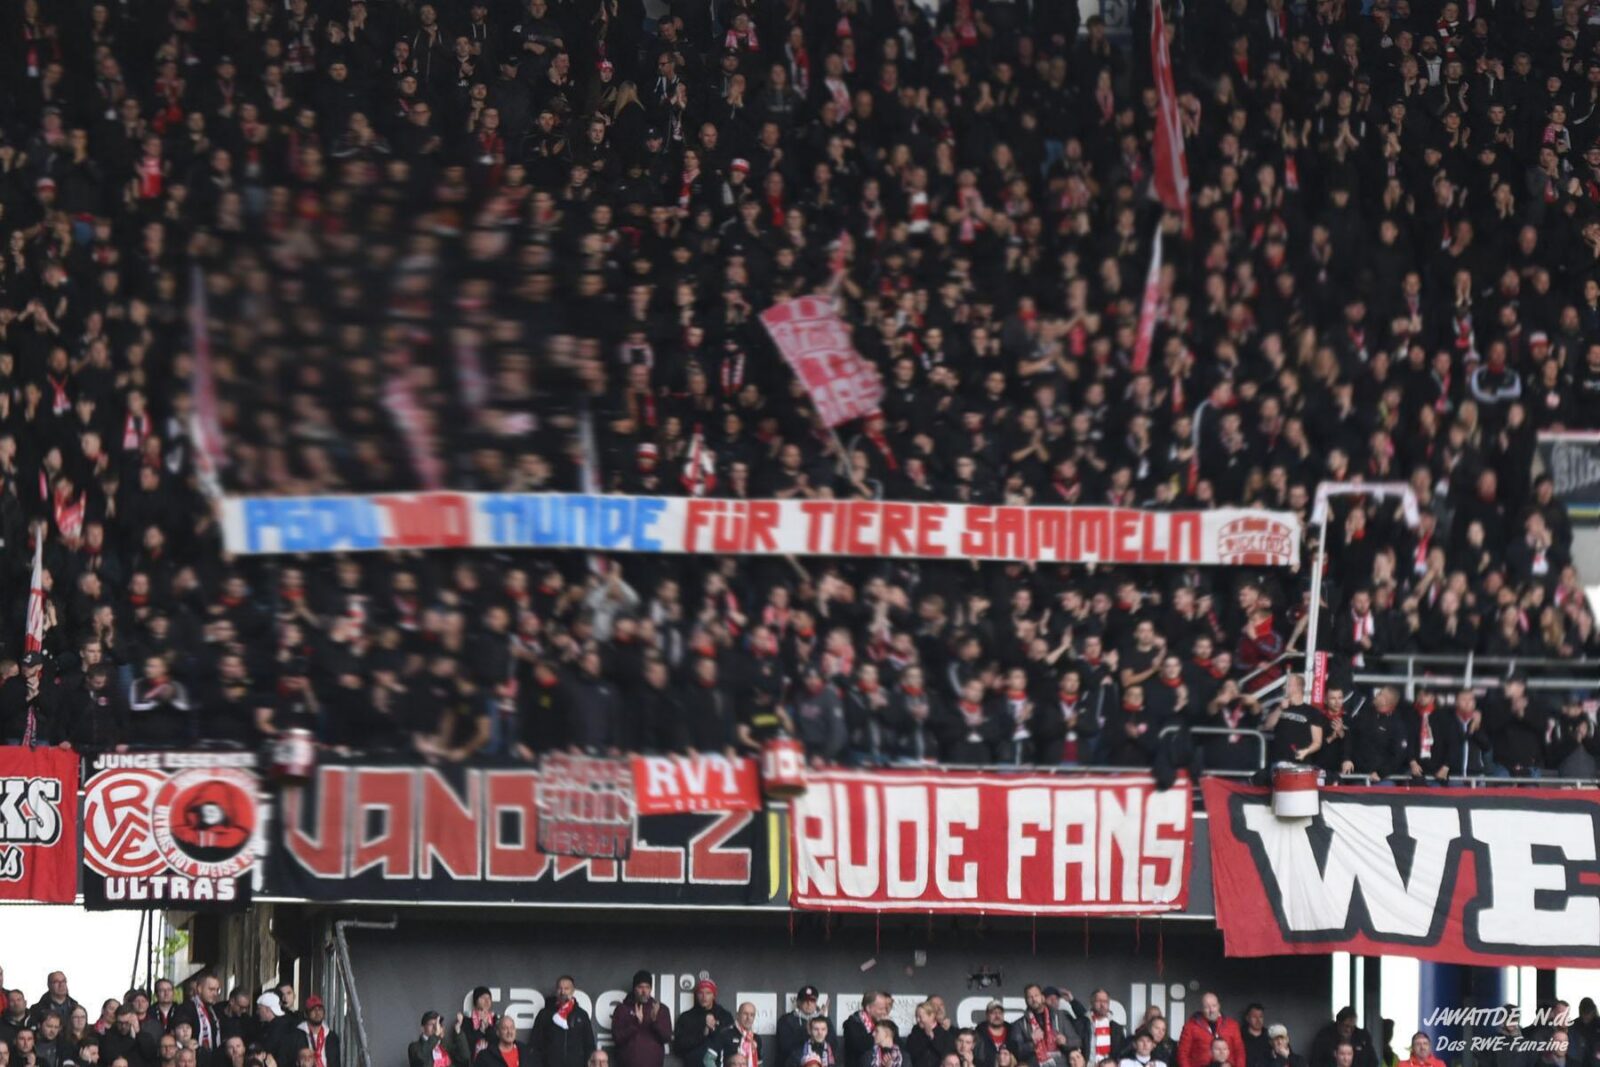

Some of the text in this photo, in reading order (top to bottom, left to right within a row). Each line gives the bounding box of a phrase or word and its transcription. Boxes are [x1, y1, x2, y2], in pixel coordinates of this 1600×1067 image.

[684, 499, 779, 554] FÜR
[802, 502, 947, 557] TIERE
[961, 506, 1201, 563] SAMMELN
[93, 753, 160, 769] JUNGE
[644, 754, 746, 797] RVT
[795, 781, 1188, 902] RUDE FANS
[106, 877, 236, 900] ULTRAS
